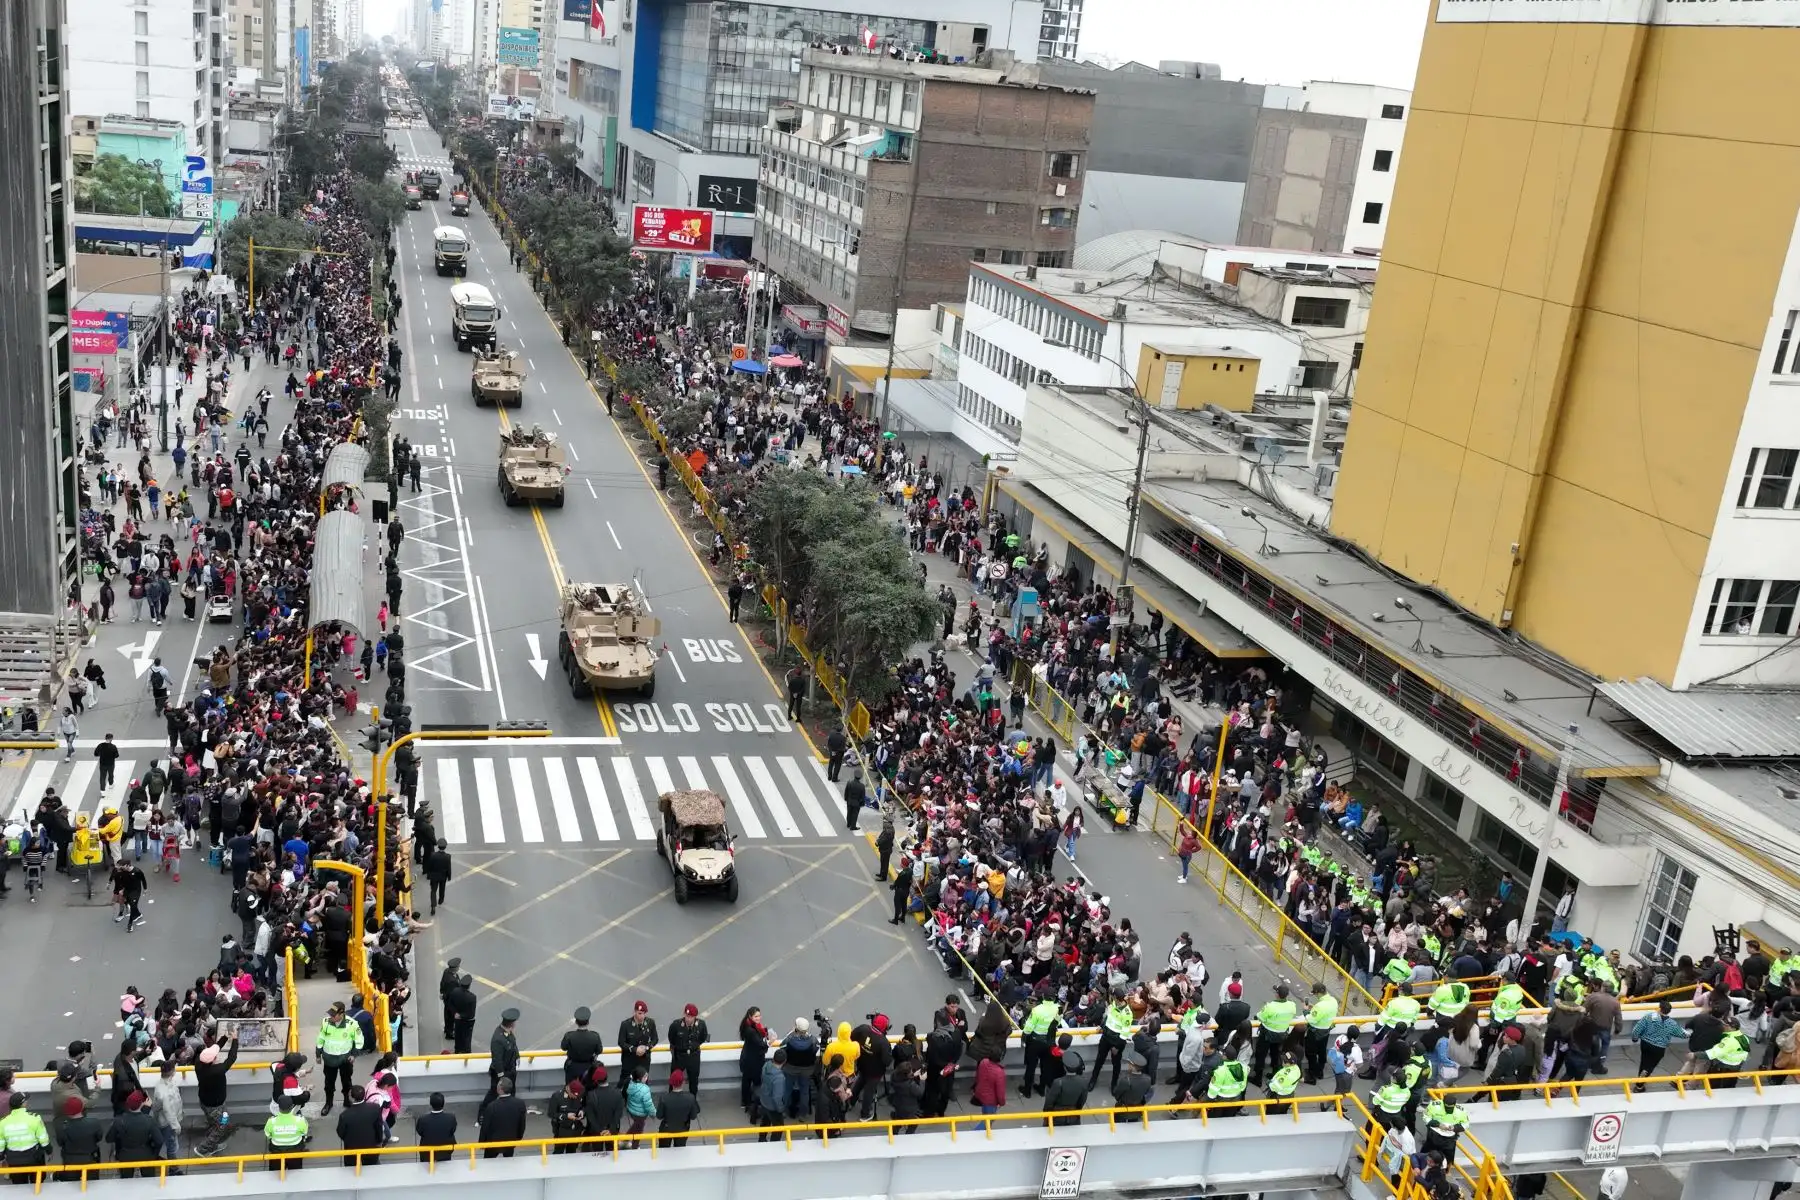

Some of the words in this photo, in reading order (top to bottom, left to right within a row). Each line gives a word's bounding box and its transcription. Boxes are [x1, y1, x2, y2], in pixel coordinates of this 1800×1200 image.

[500, 42, 537, 53] DISPONIBLE
[409, 444, 437, 457] BU
[681, 637, 743, 663] BUS
[613, 702, 701, 733] SOLO
[704, 702, 792, 733] SOLO
[1322, 666, 1405, 737] Hospital
[1431, 747, 1473, 787] del
[1046, 1179, 1076, 1187] ALTURA
